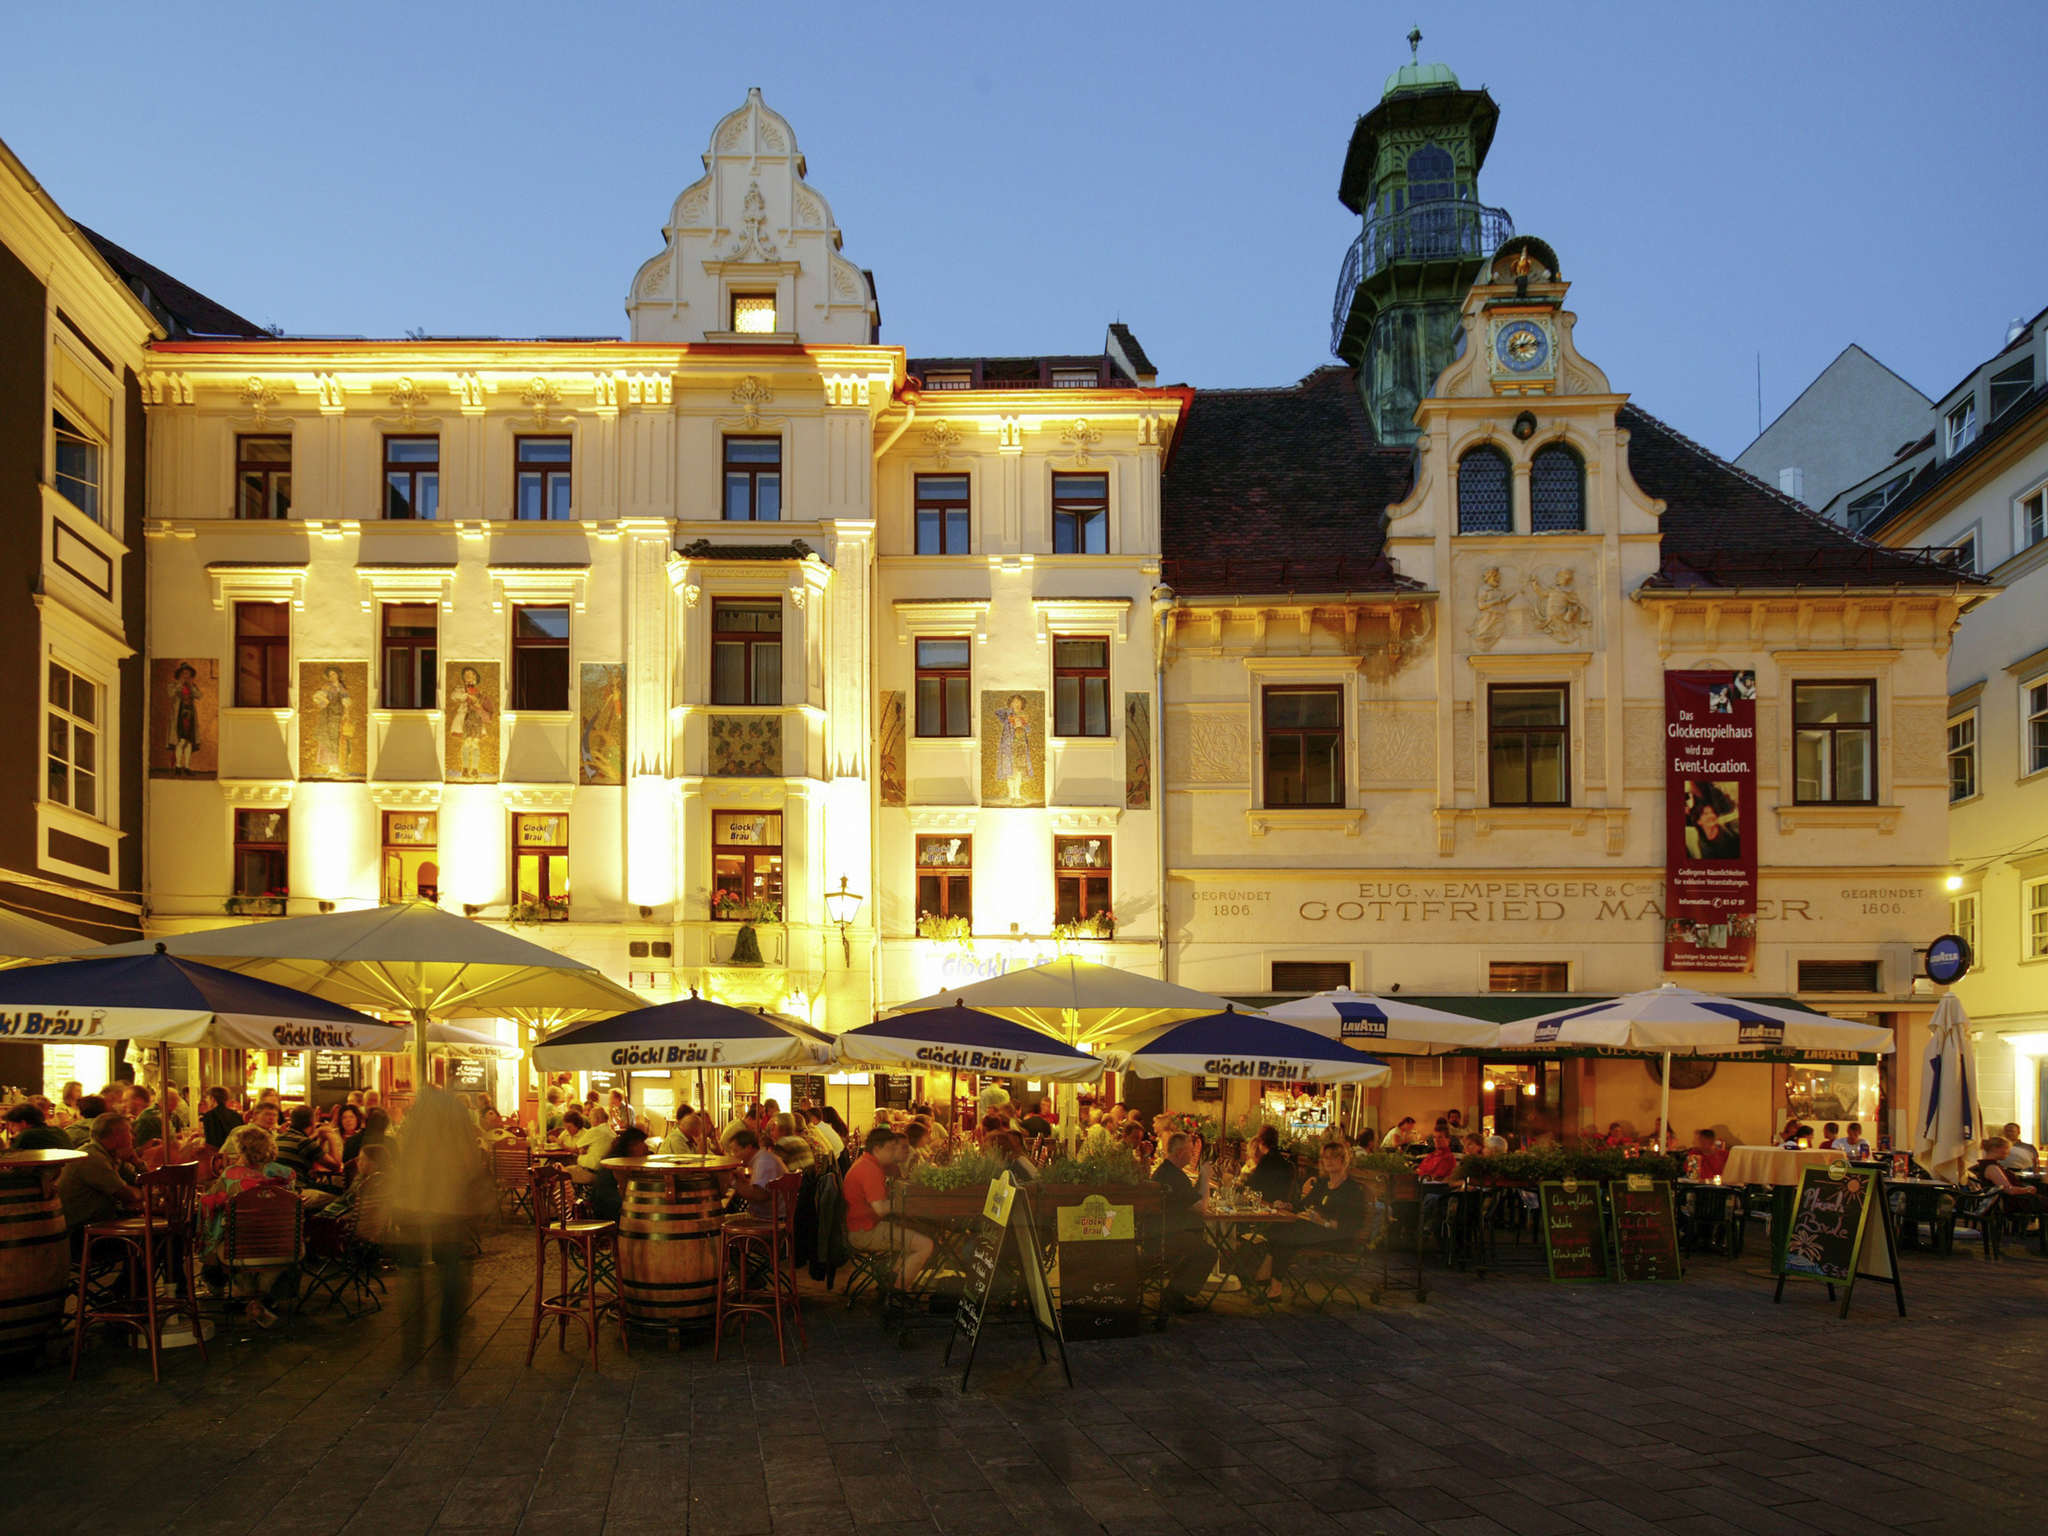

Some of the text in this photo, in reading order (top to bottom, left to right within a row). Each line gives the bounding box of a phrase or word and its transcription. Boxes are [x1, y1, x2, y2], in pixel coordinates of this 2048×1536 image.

[1680, 710, 1694, 721] Das
[1668, 723, 1753, 743] Glockenspielhaus
[1685, 745, 1715, 756] wird zur
[1674, 758, 1750, 773] Event-Location.
[1359, 883, 1418, 898] EUG.
[1443, 883, 1599, 898] EMPERGER
[1605, 886, 1617, 897] &
[1841, 888, 1924, 900] GEGRÜNDET
[1300, 901, 1566, 921] GOTTFRIED
[22, 1010, 84, 1035] Bräu
[1343, 1018, 1386, 1032] LAVAZZA
[272, 1022, 345, 1047] Glöckl Bräu
[611, 1043, 709, 1065] Glöckl Bräu
[916, 1046, 968, 1066] Glöckl
[969, 1052, 1012, 1072] Bräu
[1204, 1058, 1298, 1079] Glöckl Bräu
